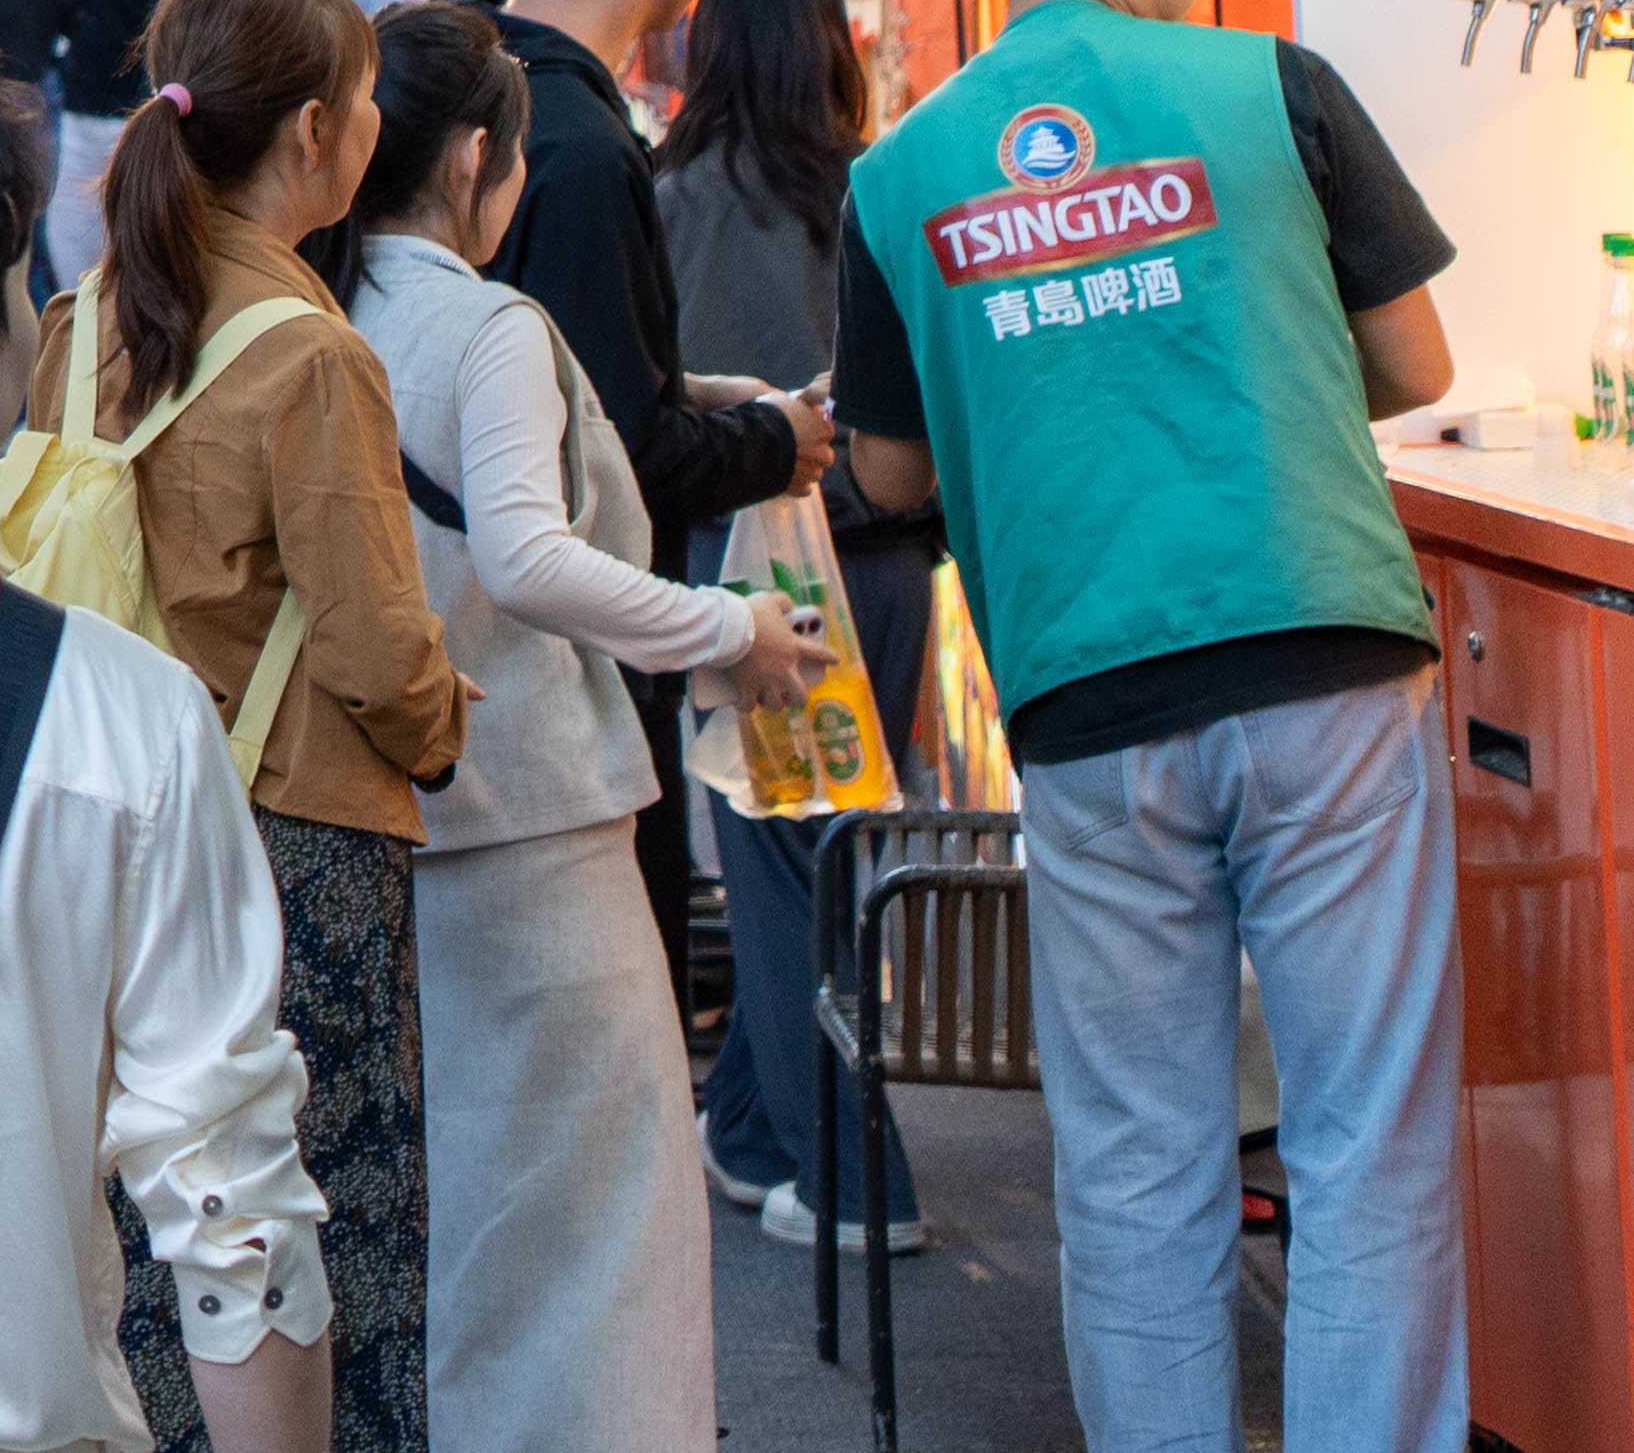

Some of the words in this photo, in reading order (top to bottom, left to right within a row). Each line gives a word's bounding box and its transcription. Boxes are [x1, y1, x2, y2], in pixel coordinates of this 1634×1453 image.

[938, 172, 1195, 271] TSINGTAO
[982, 255, 1184, 342] 青島啤酒
